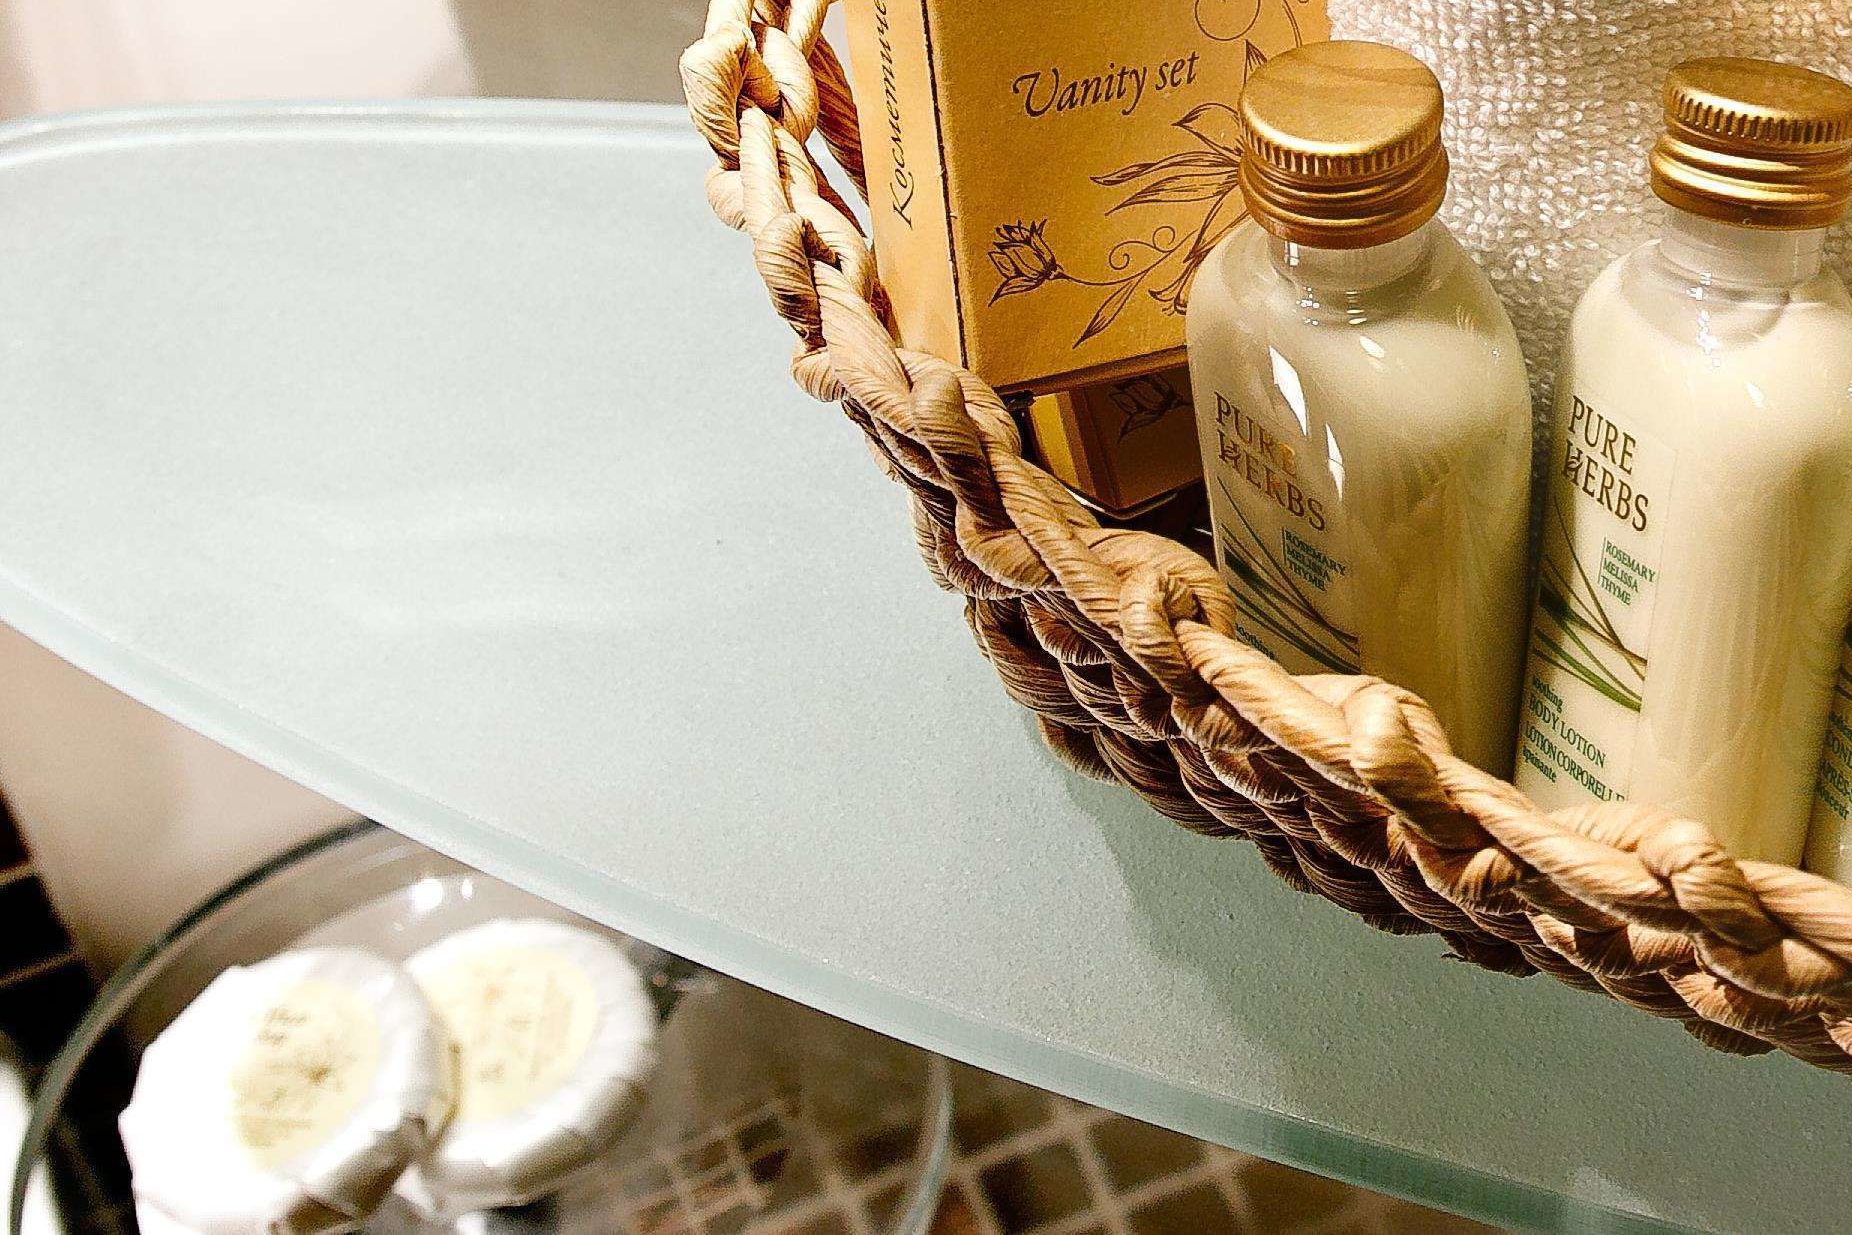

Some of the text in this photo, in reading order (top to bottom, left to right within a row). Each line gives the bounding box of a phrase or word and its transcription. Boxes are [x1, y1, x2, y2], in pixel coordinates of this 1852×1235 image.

[1012, 51, 1200, 117] Vanity set
[1213, 390, 1298, 477] PURE
[1567, 395, 1636, 476] PURE
[1216, 427, 1326, 532] HERBS
[1561, 439, 1649, 532] HERBS
[1285, 529, 1347, 576] ROSEMARY
[1603, 557, 1639, 593] MELISSA
[1606, 540, 1657, 583] ROSEMARY
[1600, 575, 1631, 606] THYME
[1525, 720, 1558, 761] LOTION
[1529, 692, 1606, 768] BODY LOTION
